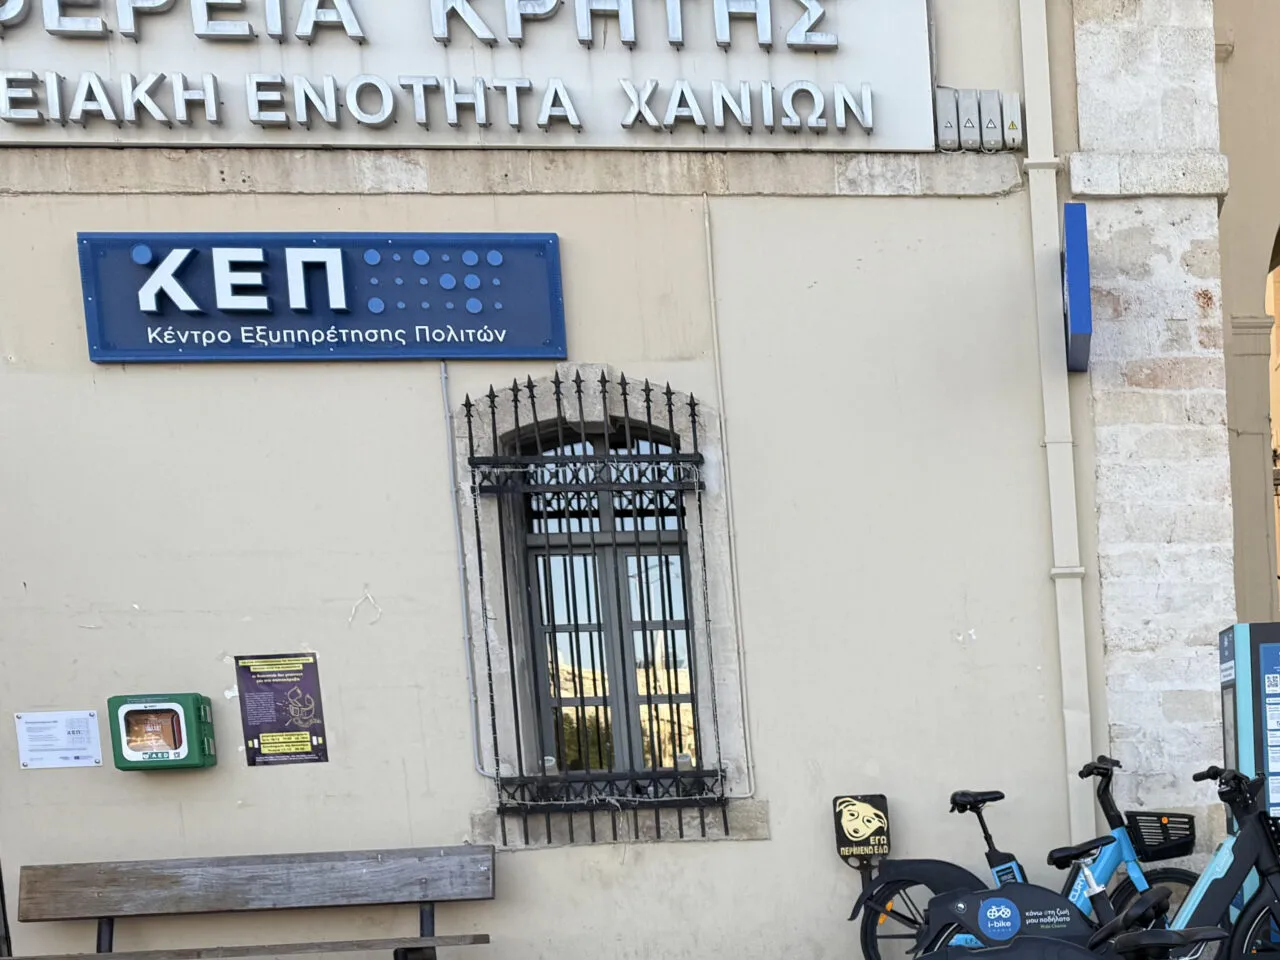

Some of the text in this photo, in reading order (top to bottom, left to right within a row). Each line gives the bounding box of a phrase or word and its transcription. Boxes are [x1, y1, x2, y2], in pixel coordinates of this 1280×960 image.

[246, 73, 583, 131] ΕΝΟΤΗΤΑ
[618, 78, 874, 134] ΧΑΝΙΩΝ
[138, 247, 348, 313] ΚΕΠ
[147, 325, 507, 347] Κέντρο Εξυπηρέτησης Πολιτών
[870, 836, 887, 845] ΕΓΩ
[988, 920, 1012, 928] i-bike
